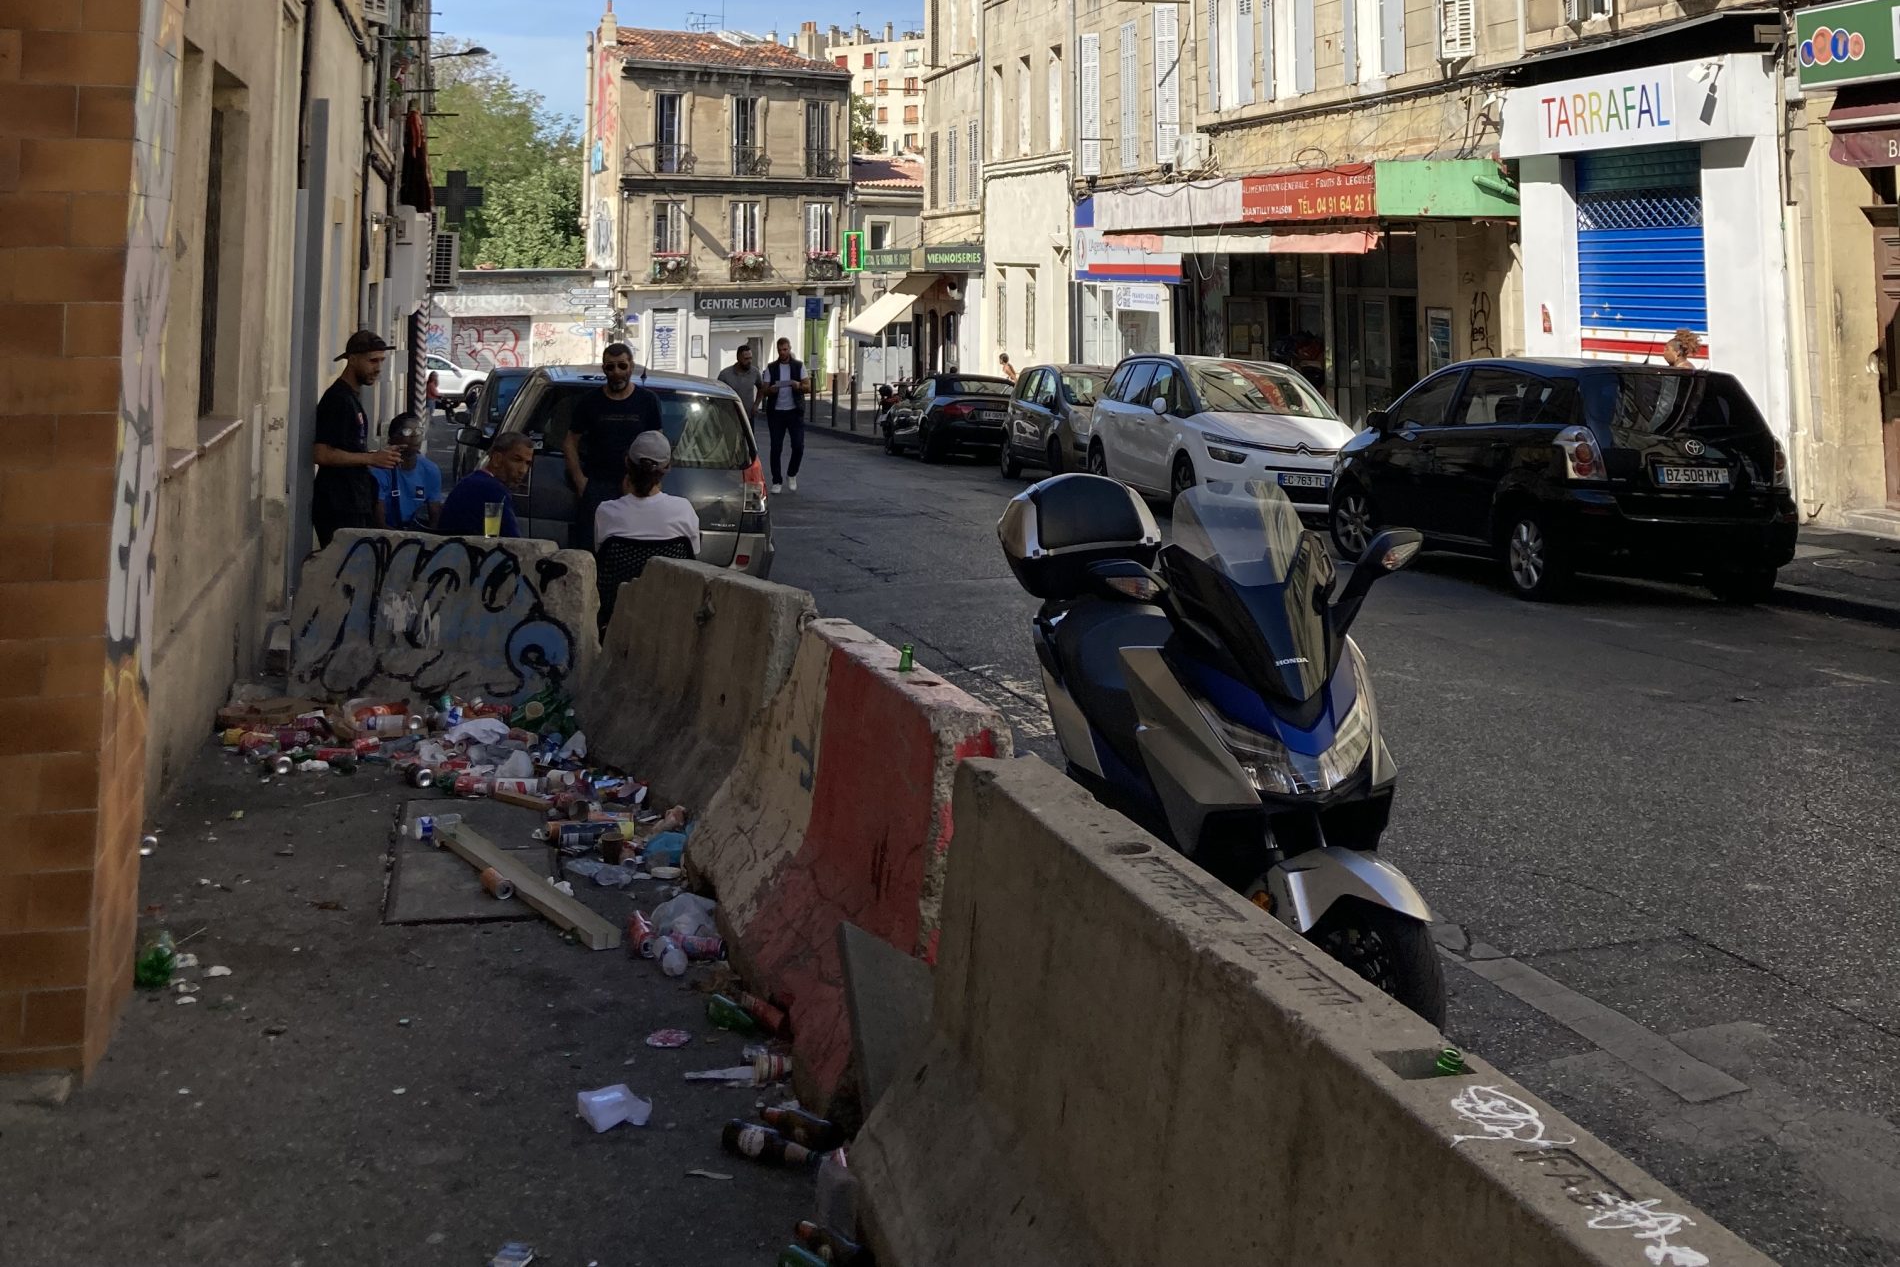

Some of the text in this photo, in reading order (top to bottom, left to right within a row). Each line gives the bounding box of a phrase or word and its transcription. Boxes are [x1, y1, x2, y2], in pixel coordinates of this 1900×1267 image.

[1541, 82, 1670, 138] TARRAFAL
[1242, 183, 1280, 194] ALIMENTATION
[1315, 178, 1335, 188] FRUITS
[1336, 177, 1342, 186] &
[1242, 206, 1271, 216] CHANTILLY
[1271, 204, 1292, 214] MAISON
[1298, 196, 1314, 214] TÉL.
[1316, 197, 1326, 213] 04
[1328, 197, 1337, 213] 91
[1339, 195, 1351, 212] 64
[1354, 195, 1365, 212] 26
[927, 252, 981, 263] VIENNOISERIES
[700, 297, 788, 310] CENTRE MEDICAL
[1275, 657, 1309, 666] HONDA
